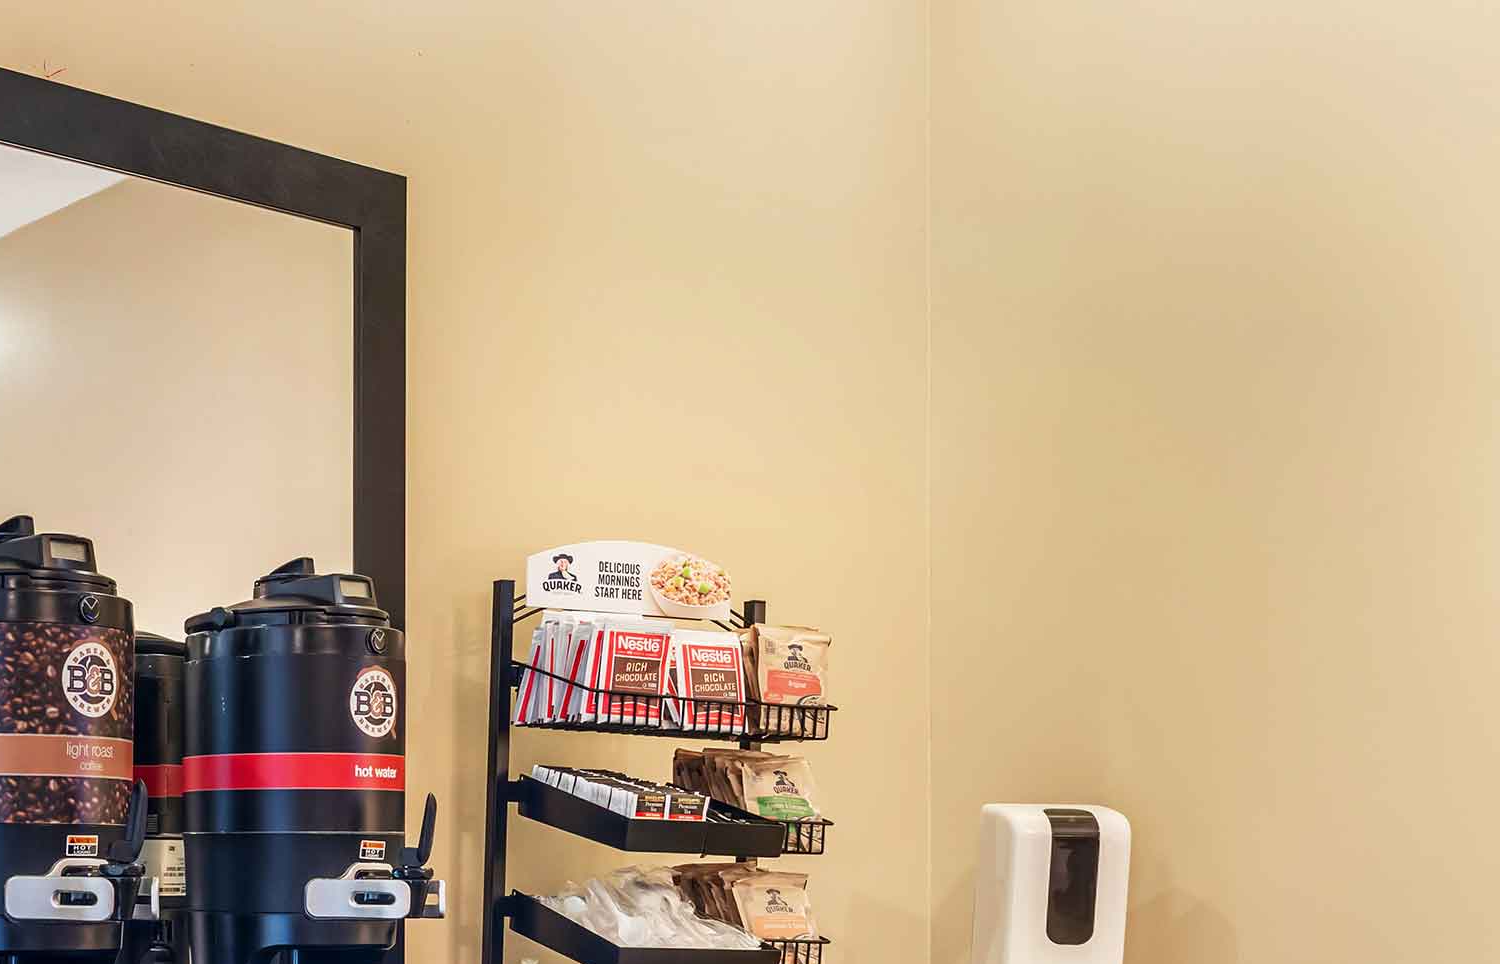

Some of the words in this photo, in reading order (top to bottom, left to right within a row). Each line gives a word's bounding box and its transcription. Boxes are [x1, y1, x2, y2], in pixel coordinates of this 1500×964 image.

[598, 561, 641, 575] DELICIOUS
[542, 580, 582, 594] QUAKER
[597, 574, 641, 588] MORNINGS
[594, 586, 619, 599] START
[621, 589, 642, 600] HERE
[626, 662, 649, 673] RICH
[783, 661, 812, 672] QUAKER
[67, 665, 114, 696] B&B
[615, 672, 657, 683] CHOCOLATE
[704, 673, 725, 683] RICH
[694, 682, 737, 692] CHOCOLATE
[354, 691, 394, 718] B&B
[66, 742, 89, 760] light
[91, 744, 114, 759] roast
[355, 765, 373, 778] hot
[375, 767, 397, 779] water
